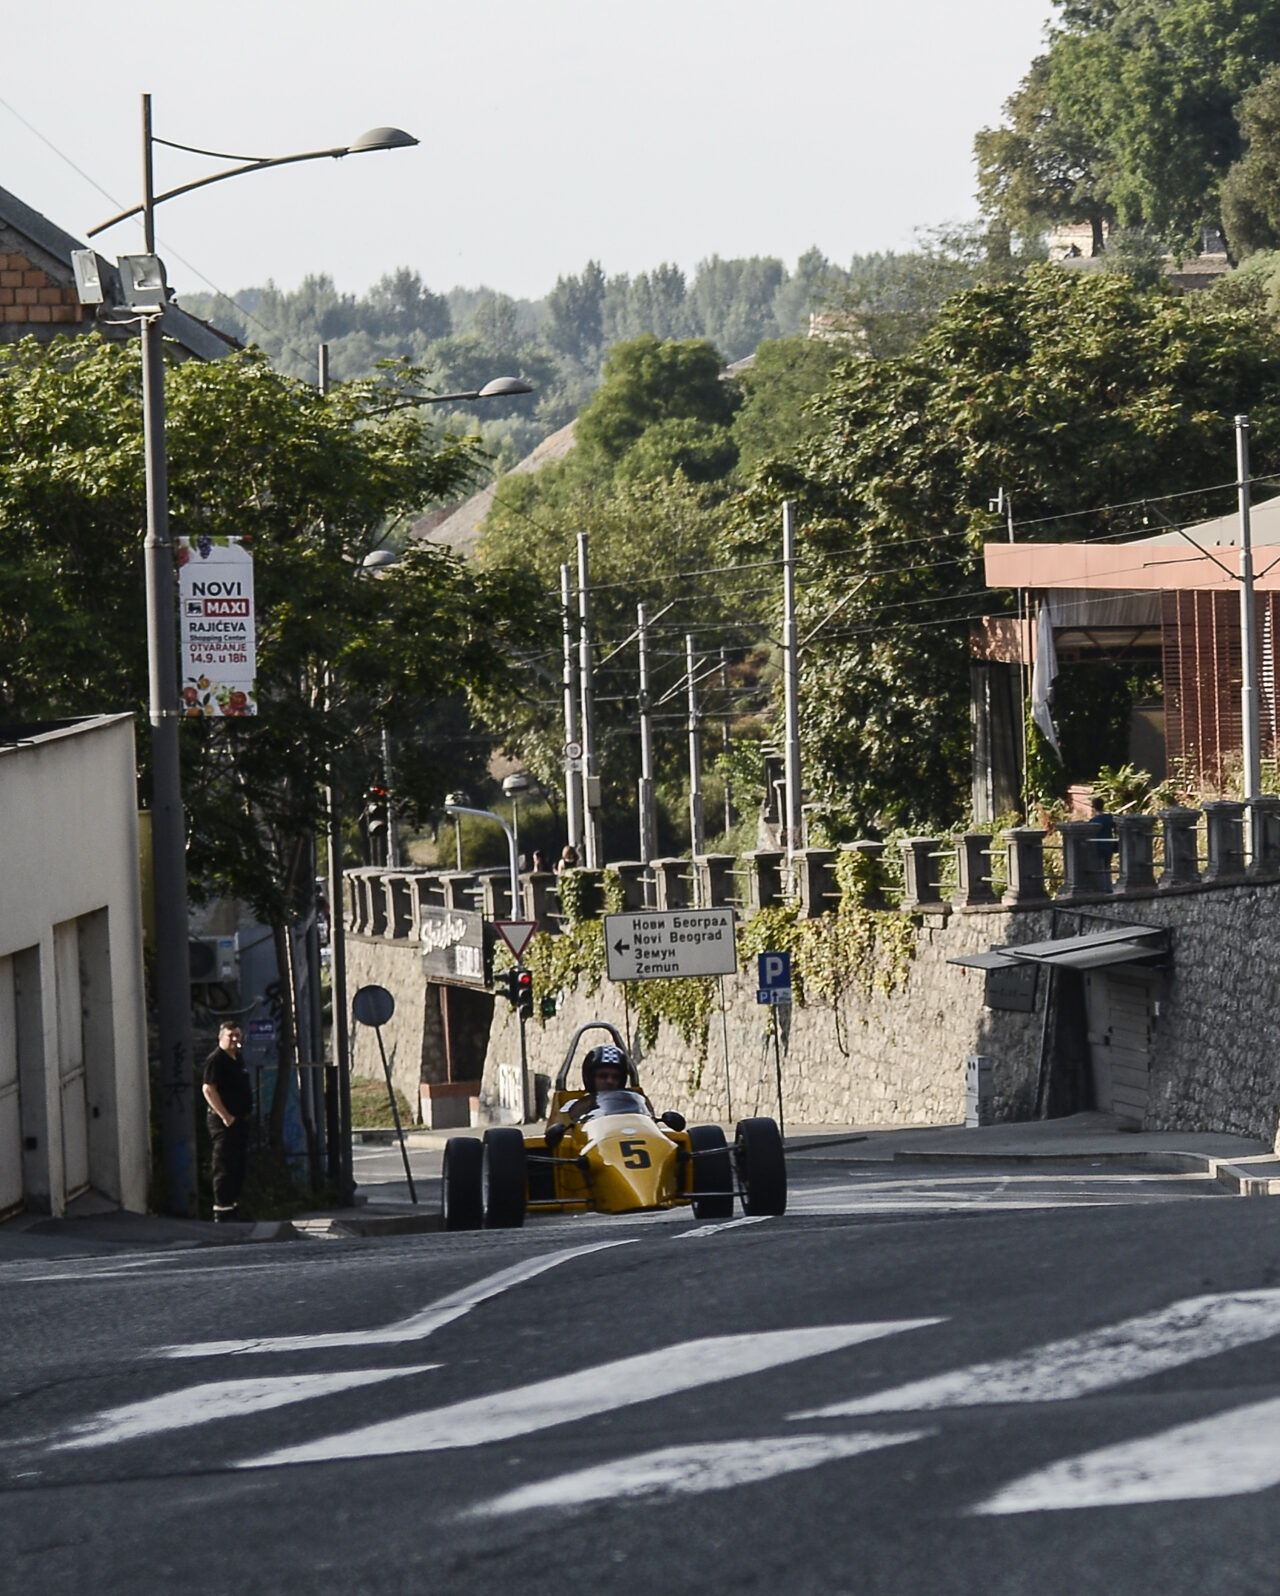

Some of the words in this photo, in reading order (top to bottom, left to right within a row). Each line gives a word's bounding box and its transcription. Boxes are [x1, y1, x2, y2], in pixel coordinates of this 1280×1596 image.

[192, 582, 241, 596] NOVI
[207, 602, 246, 613] MAXI
[189, 620, 246, 632] RAJIĆEVA
[190, 634, 222, 642] Shopping
[190, 643, 247, 652] OTVARANJE
[190, 653, 216, 663] 14.9.
[219, 655, 226, 663] u
[228, 653, 247, 663] 18h
[633, 919, 665, 930] Нови
[673, 917, 727, 929] Београд
[633, 933, 662, 945] Novi
[670, 930, 722, 945] Beograd
[634, 948, 676, 960] Земун
[636, 963, 680, 974] Zemun
[766, 956, 783, 985] P
[760, 991, 768, 1002] P
[619, 1140, 652, 1170] 5
